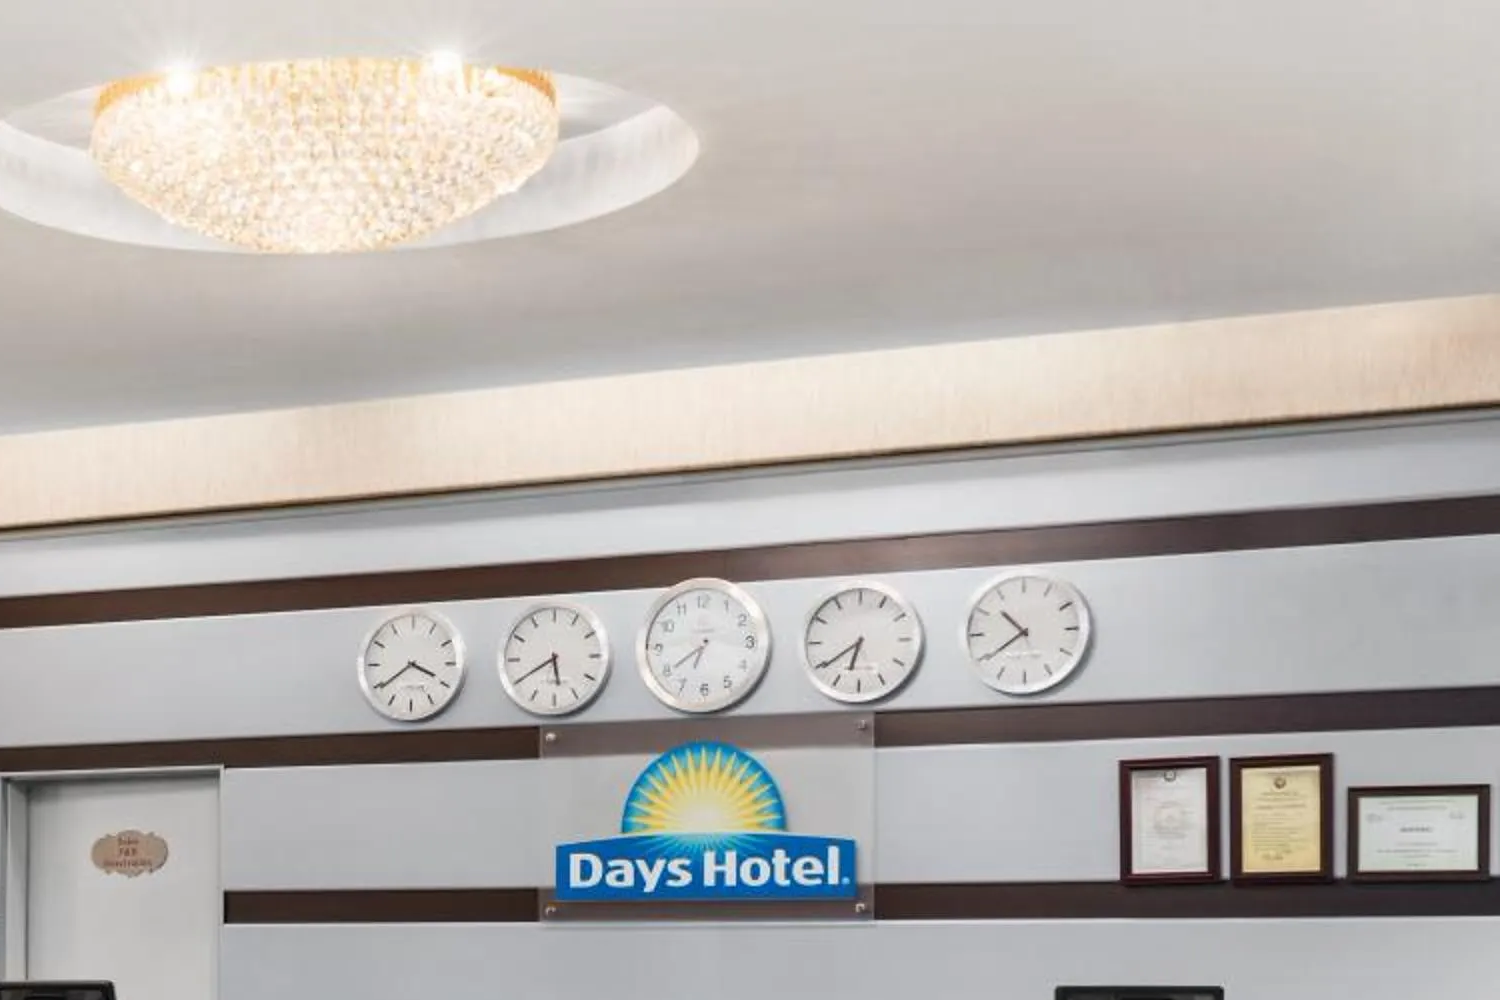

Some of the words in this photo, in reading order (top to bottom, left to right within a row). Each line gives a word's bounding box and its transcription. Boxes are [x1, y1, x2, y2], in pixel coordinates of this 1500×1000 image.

[738, 613, 748, 627] 2
[745, 635, 755, 649] 3
[723, 675, 733, 689] 5
[700, 683, 709, 697] 6
[568, 852, 693, 893] Days
[702, 845, 841, 887] Hotel
